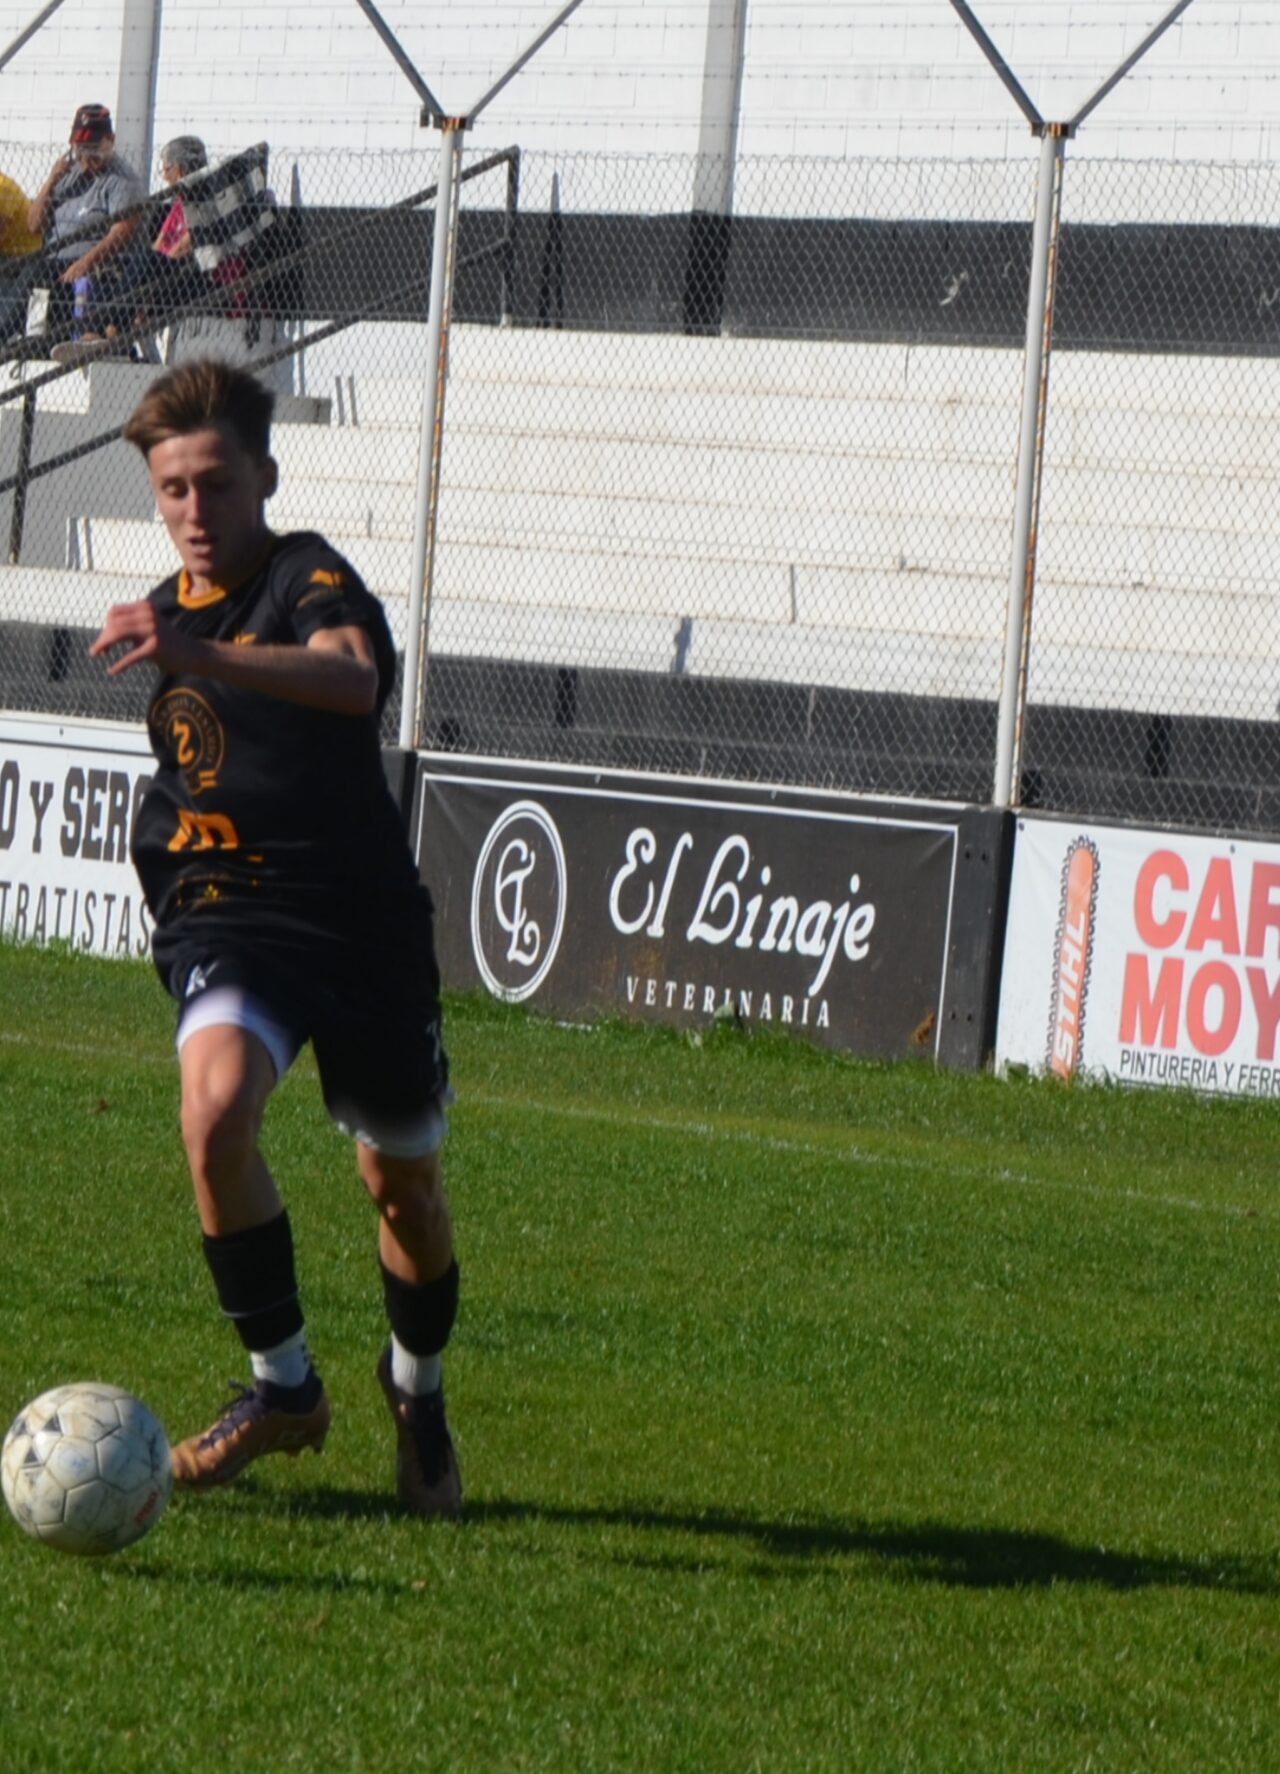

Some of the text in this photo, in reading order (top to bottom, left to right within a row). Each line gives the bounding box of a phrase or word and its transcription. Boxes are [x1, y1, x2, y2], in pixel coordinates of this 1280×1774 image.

[609, 828, 876, 996] El Linaje
[1053, 911, 1087, 1069] STIHL
[1120, 1048, 1218, 1086] PINTURERIA
[1224, 1061, 1235, 1088] Y
